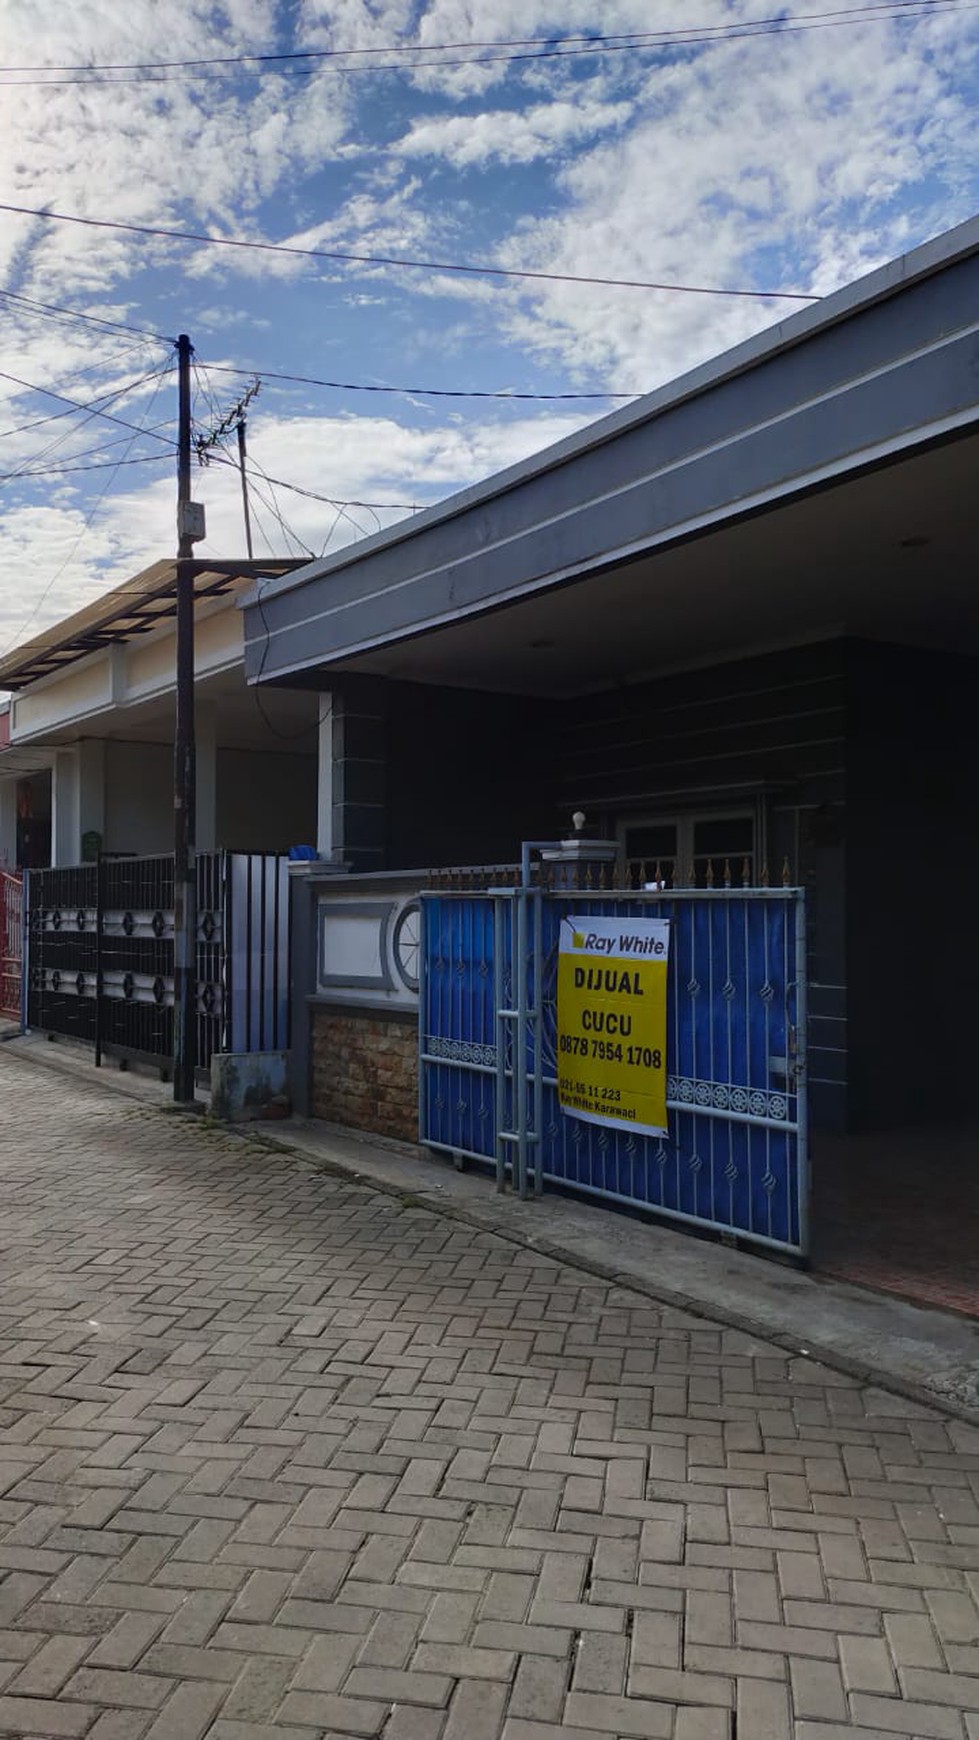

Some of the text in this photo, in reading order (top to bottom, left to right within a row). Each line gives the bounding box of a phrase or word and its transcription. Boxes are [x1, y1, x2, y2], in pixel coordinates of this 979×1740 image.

[585, 934, 616, 954] Ray
[575, 968, 644, 995] DIJUAL
[582, 1010, 632, 1036] CUCU
[560, 1035, 661, 1069] 0878 7954 1708
[588, 1085, 598, 1098] 11
[602, 1088, 620, 1101] 223
[595, 1101, 636, 1119] Karawaci
